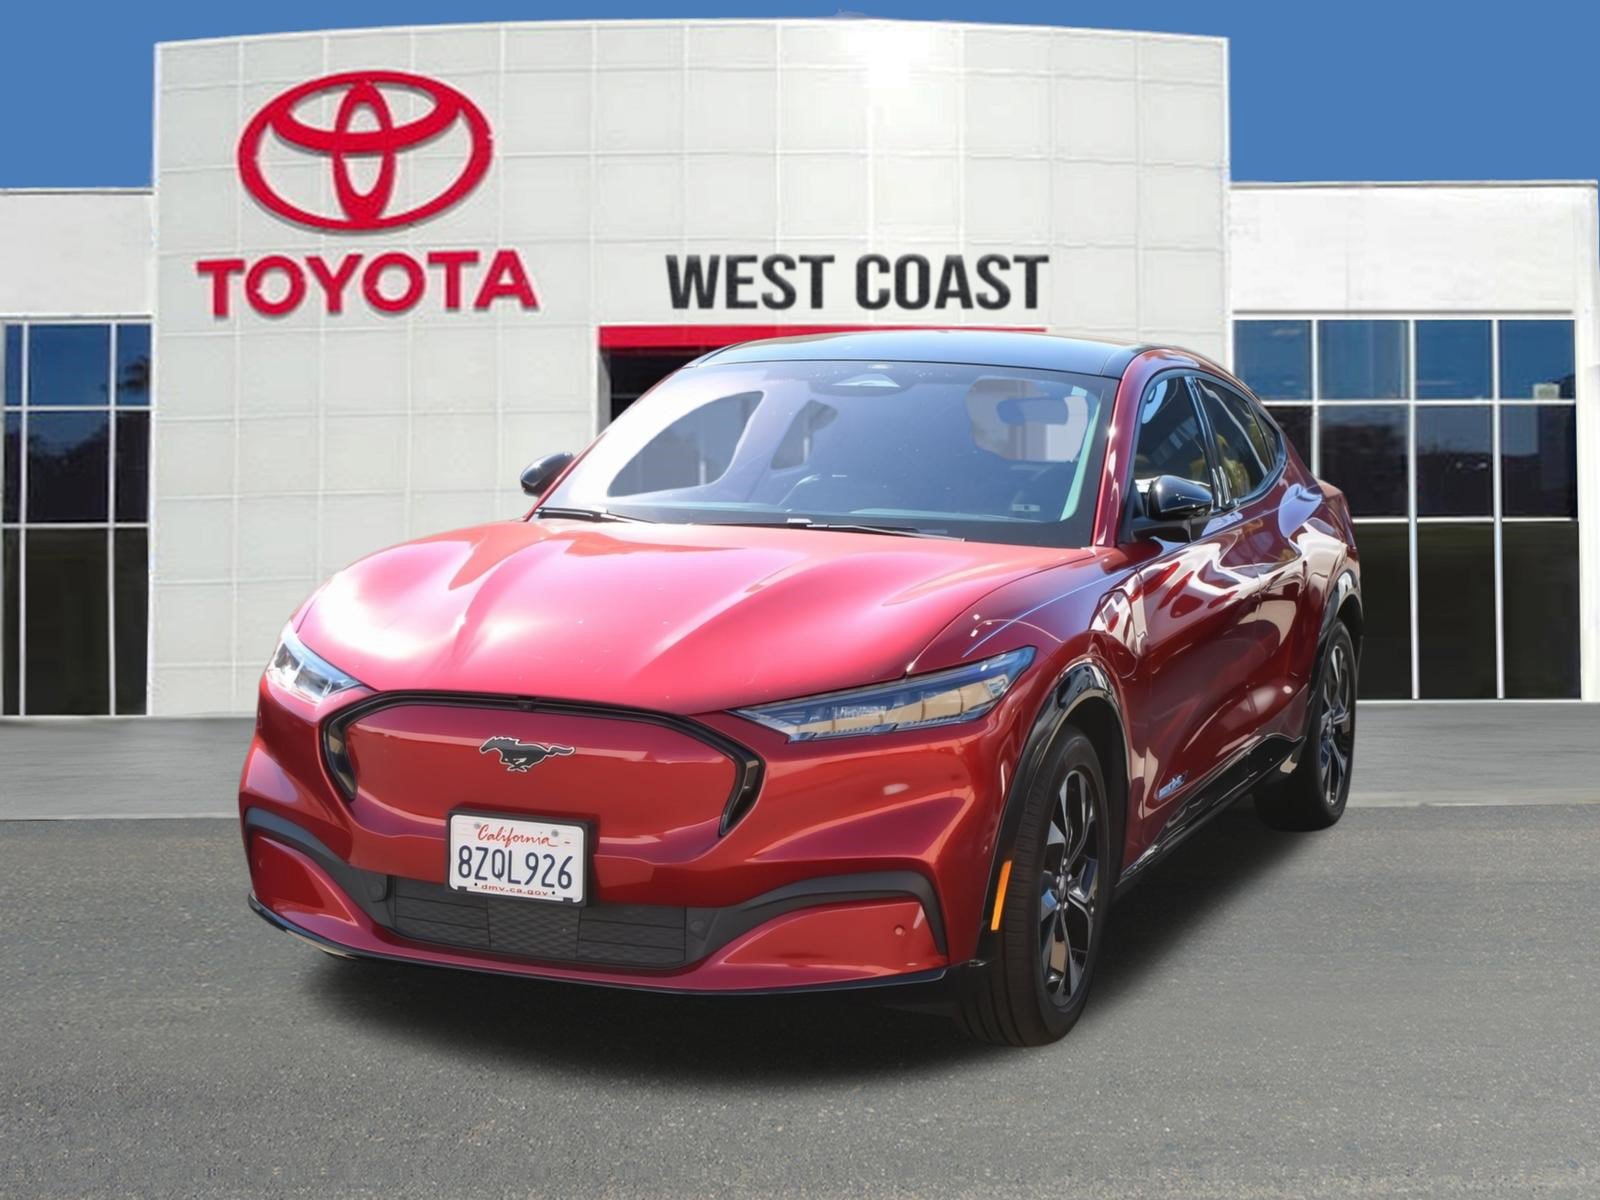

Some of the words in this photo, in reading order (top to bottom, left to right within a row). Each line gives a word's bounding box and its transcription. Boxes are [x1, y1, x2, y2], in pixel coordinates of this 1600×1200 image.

[196, 249, 539, 318] TOYOTA
[666, 254, 835, 309] WEST
[856, 254, 1049, 310] COAST
[477, 824, 558, 847] California
[458, 845, 573, 889] 8ZQL926
[481, 884, 548, 896] dmv.ca.gov
